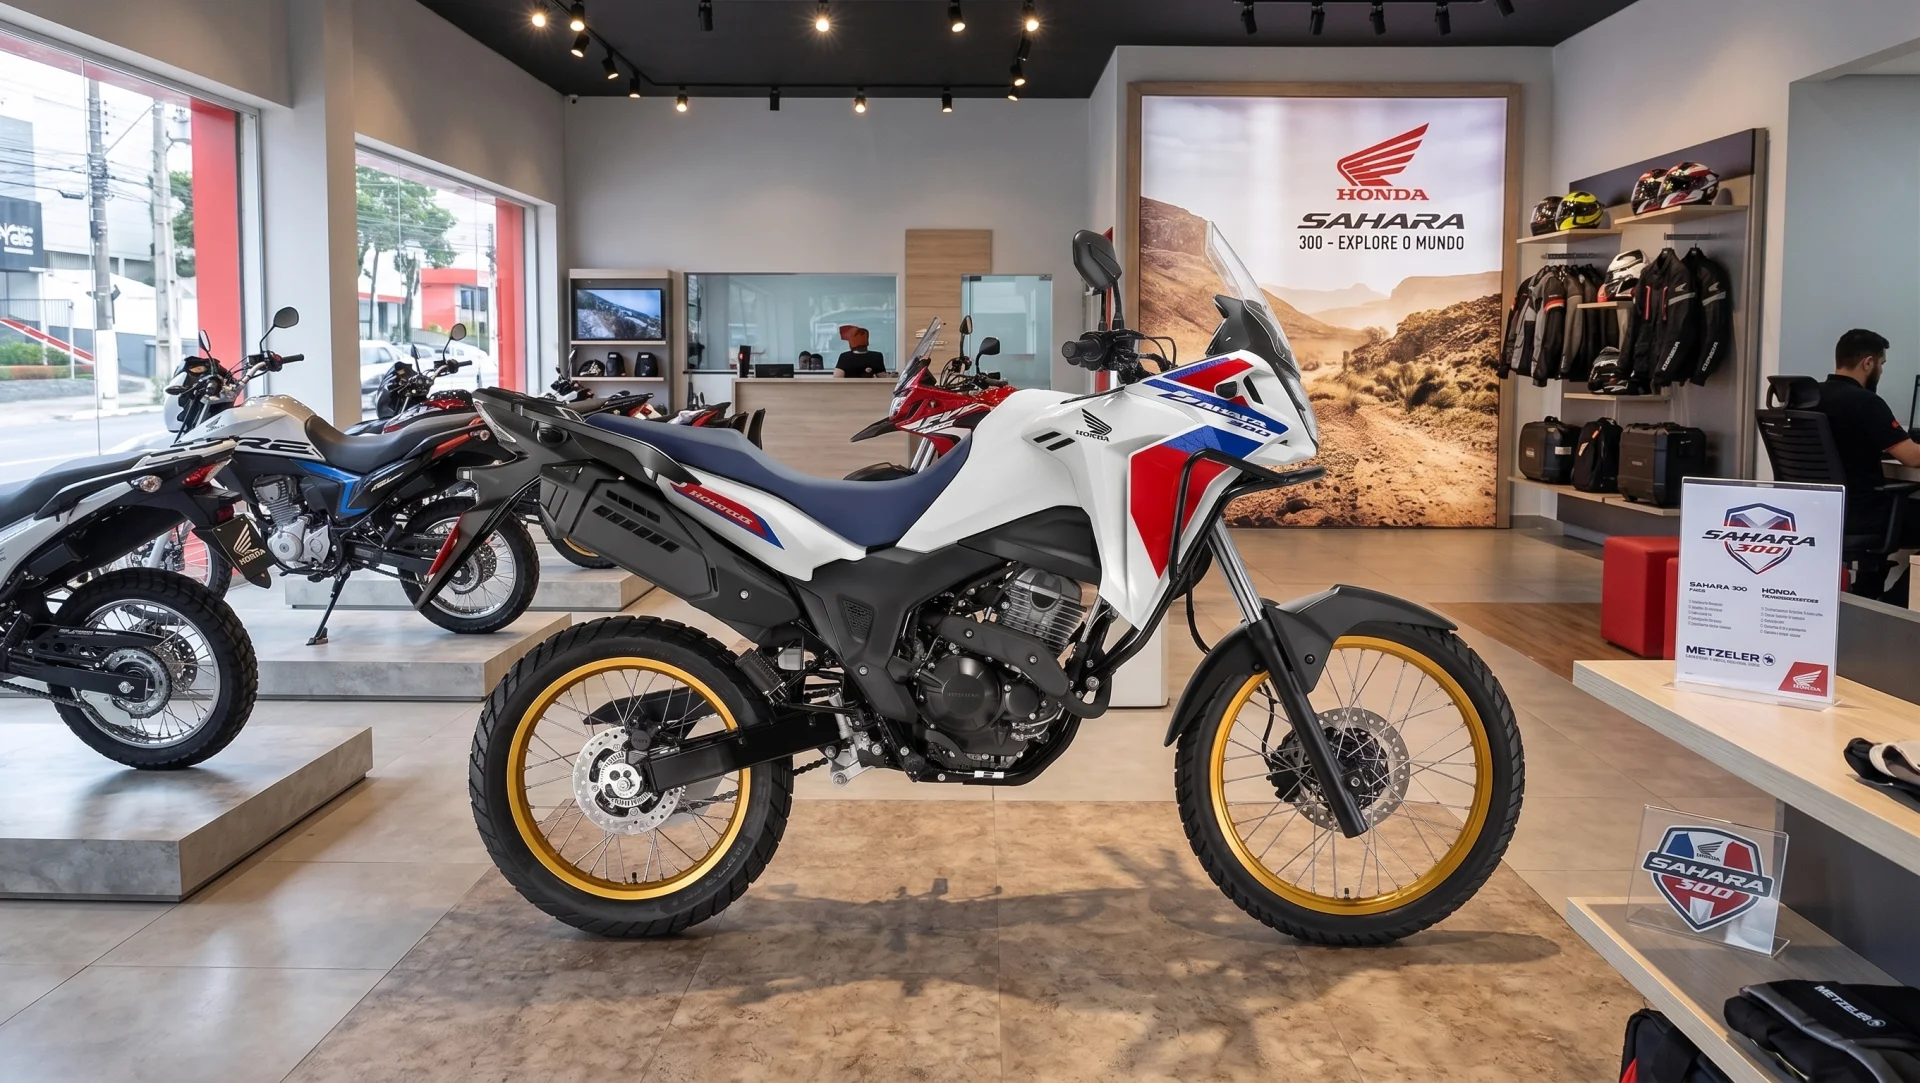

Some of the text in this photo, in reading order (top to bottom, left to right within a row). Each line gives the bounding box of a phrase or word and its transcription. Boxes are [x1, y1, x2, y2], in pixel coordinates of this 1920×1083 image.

[1336, 188, 1430, 201] HONDA
[1297, 213, 1465, 230] SAHARA
[1299, 235, 1323, 250] 300
[1338, 235, 1398, 250] EXPLORE
[1402, 235, 1411, 250] O
[1416, 235, 1464, 250] MUNDO
[1702, 529, 1816, 547] SAHARA
[239, 548, 266, 566] HONDA
[1734, 543, 1784, 555] 300
[1689, 581, 1730, 591] SAHARA
[1761, 587, 1797, 597] HONDA
[1686, 645, 1760, 663] METZELER
[1649, 856, 1764, 893] SAHARA
[1675, 878, 1735, 900] 300
